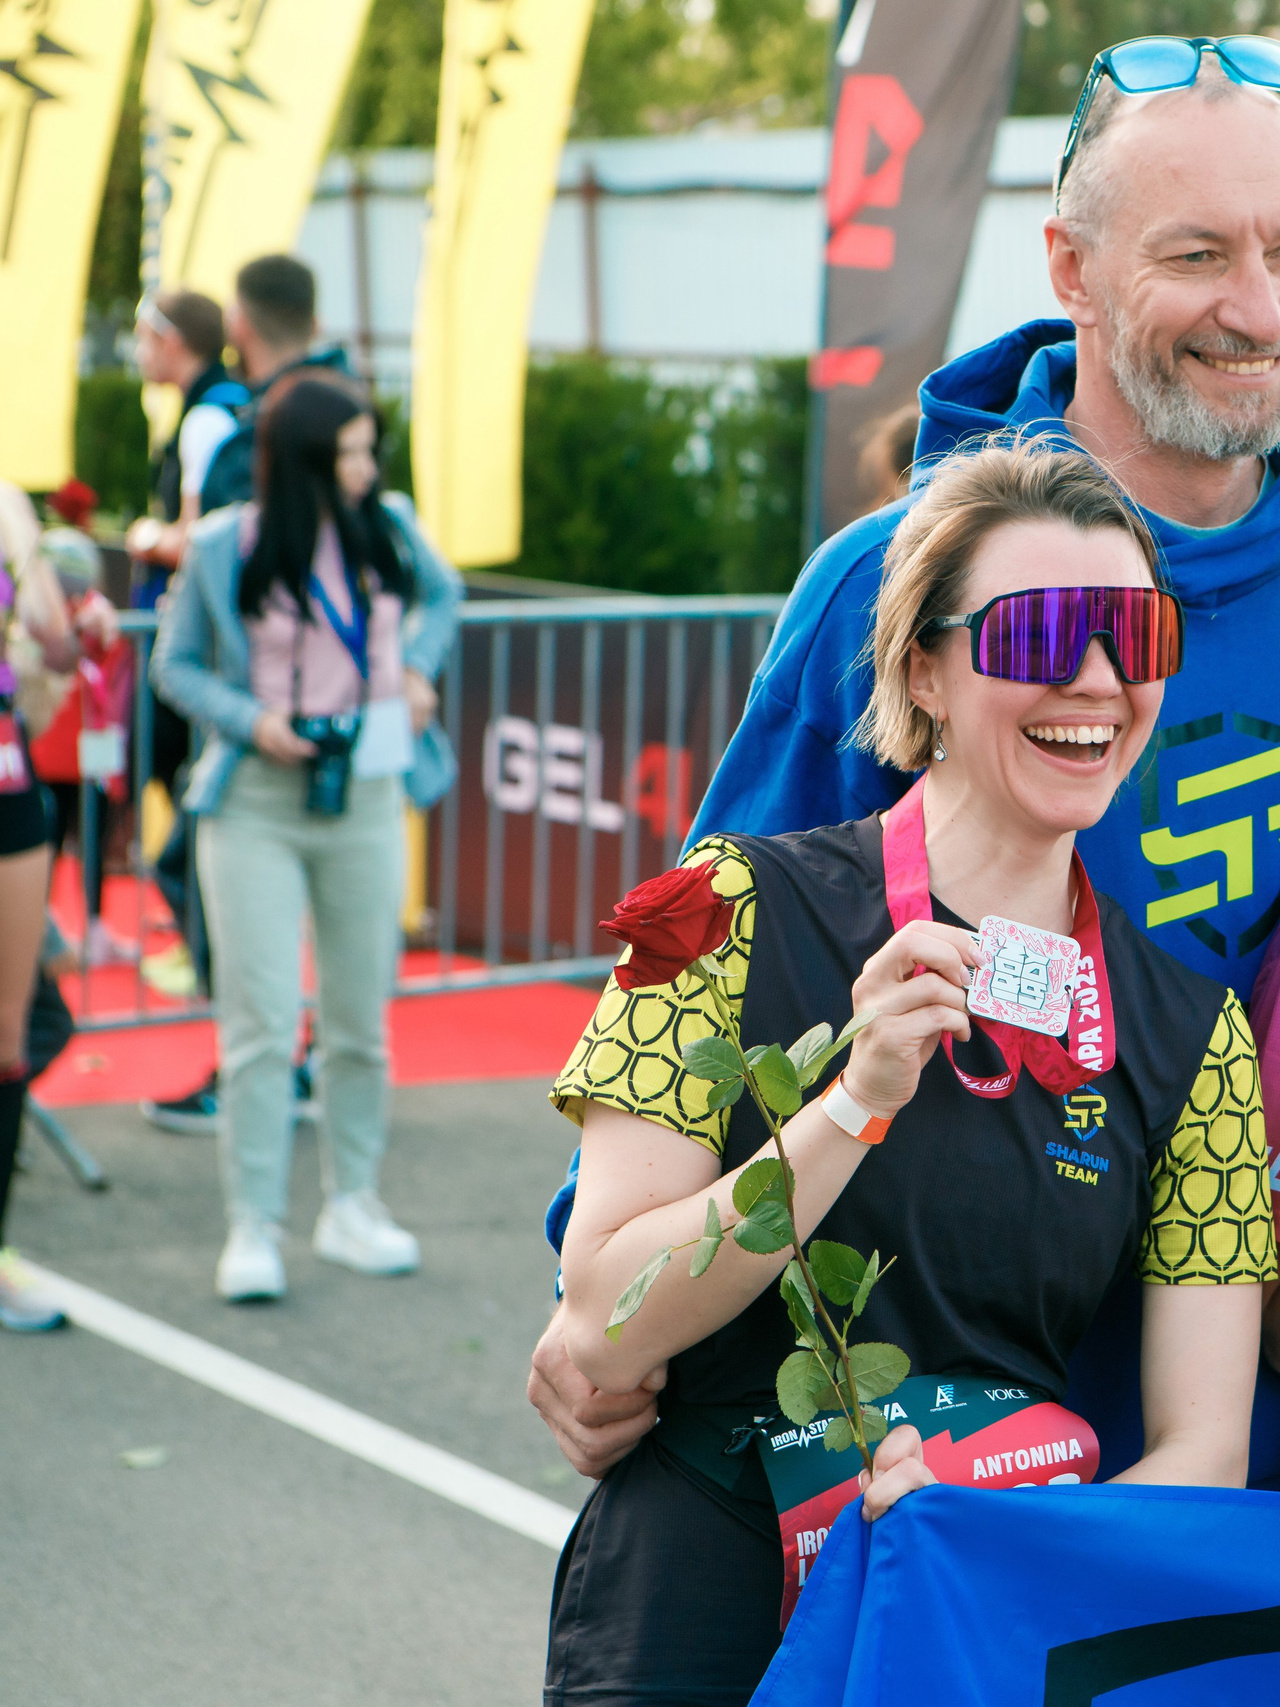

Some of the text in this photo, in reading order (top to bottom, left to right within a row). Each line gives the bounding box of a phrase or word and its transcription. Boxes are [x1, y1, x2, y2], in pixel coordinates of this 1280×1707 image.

[1074, 955, 1102, 1023] 2023
[1045, 1141, 1110, 1173] SHARUN
[1055, 1160, 1099, 1186] TEAM
[770, 1429, 799, 1448] IRON
[984, 1388, 1030, 1402] VOICE
[973, 1438, 1084, 1481] ANTONINA
[796, 1526, 833, 1557] IRO
